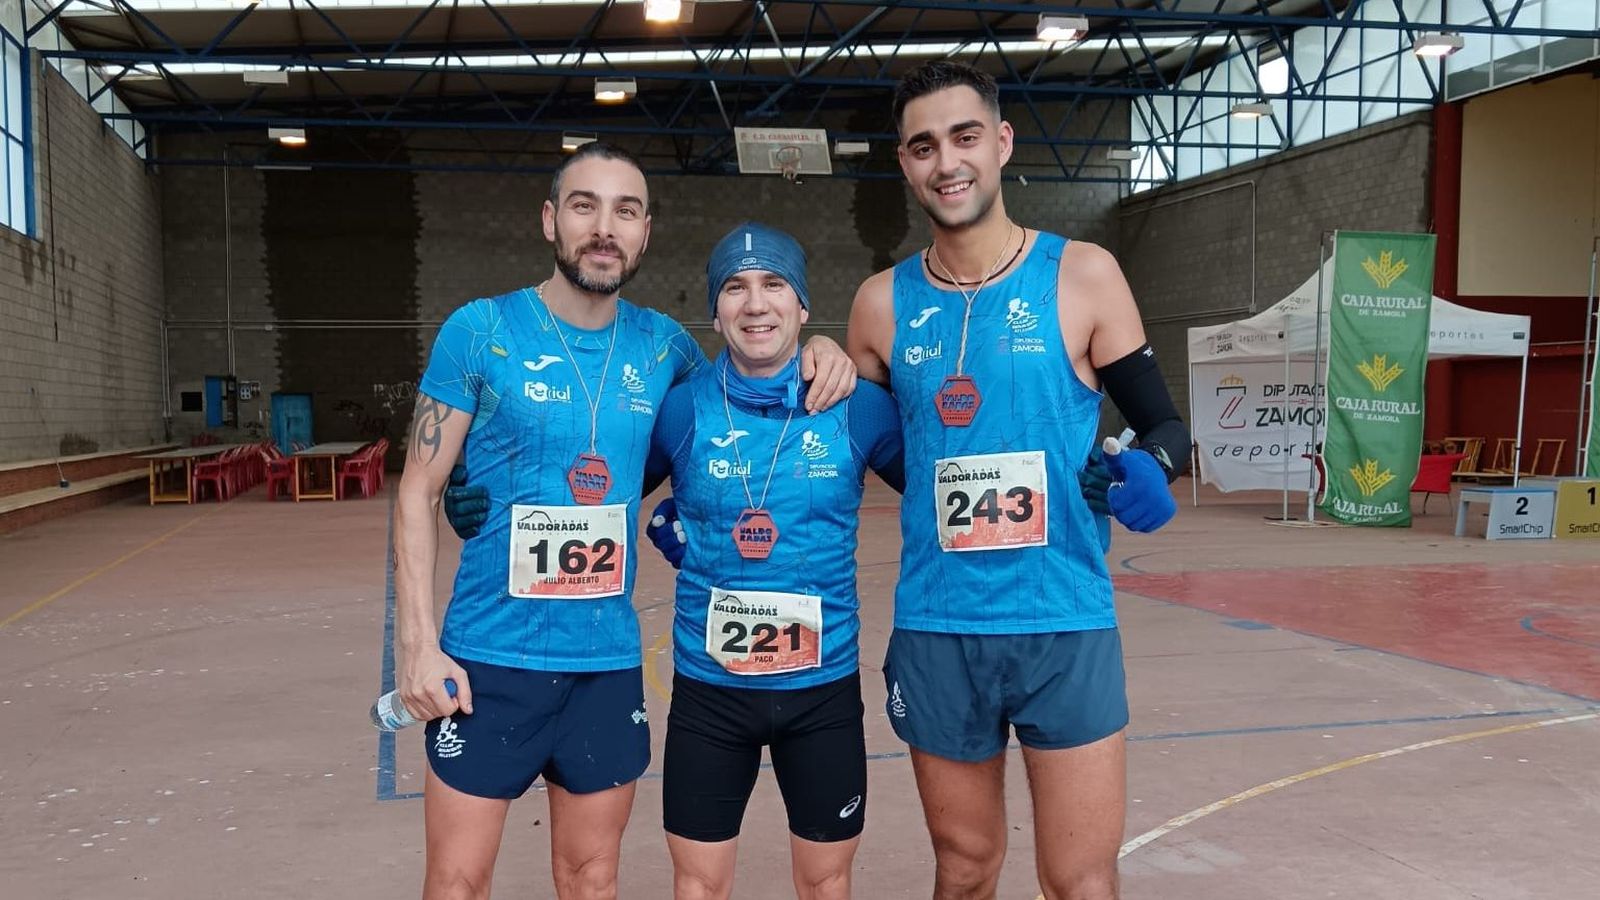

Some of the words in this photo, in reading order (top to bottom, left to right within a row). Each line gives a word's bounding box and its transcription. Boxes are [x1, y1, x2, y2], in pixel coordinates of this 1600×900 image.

[1341, 293, 1375, 307] CAJA
[1376, 296, 1427, 309] RURAL
[1359, 308, 1369, 316] DE
[1372, 309, 1406, 318] ZAMORA
[1012, 345, 1046, 353] ZAMORA
[1336, 396, 1368, 411] CAJA
[1372, 400, 1421, 415] RURAL
[1255, 406, 1326, 427] ZAMO
[1367, 413, 1400, 423] ZAMORA
[808, 470, 839, 478] ZAMORA
[938, 471, 1001, 484] VALDORADAS
[1587, 487, 1596, 505] 1
[946, 486, 1034, 527] 243
[1515, 497, 1529, 515] 2
[517, 522, 589, 531] VALDORADAS
[1500, 524, 1543, 534] SmartChip
[529, 538, 615, 575] 162
[568, 576, 600, 584] ALBERTO
[713, 603, 778, 616] VALDORADAS
[721, 621, 801, 654] 221
[754, 655, 774, 663] PACO
